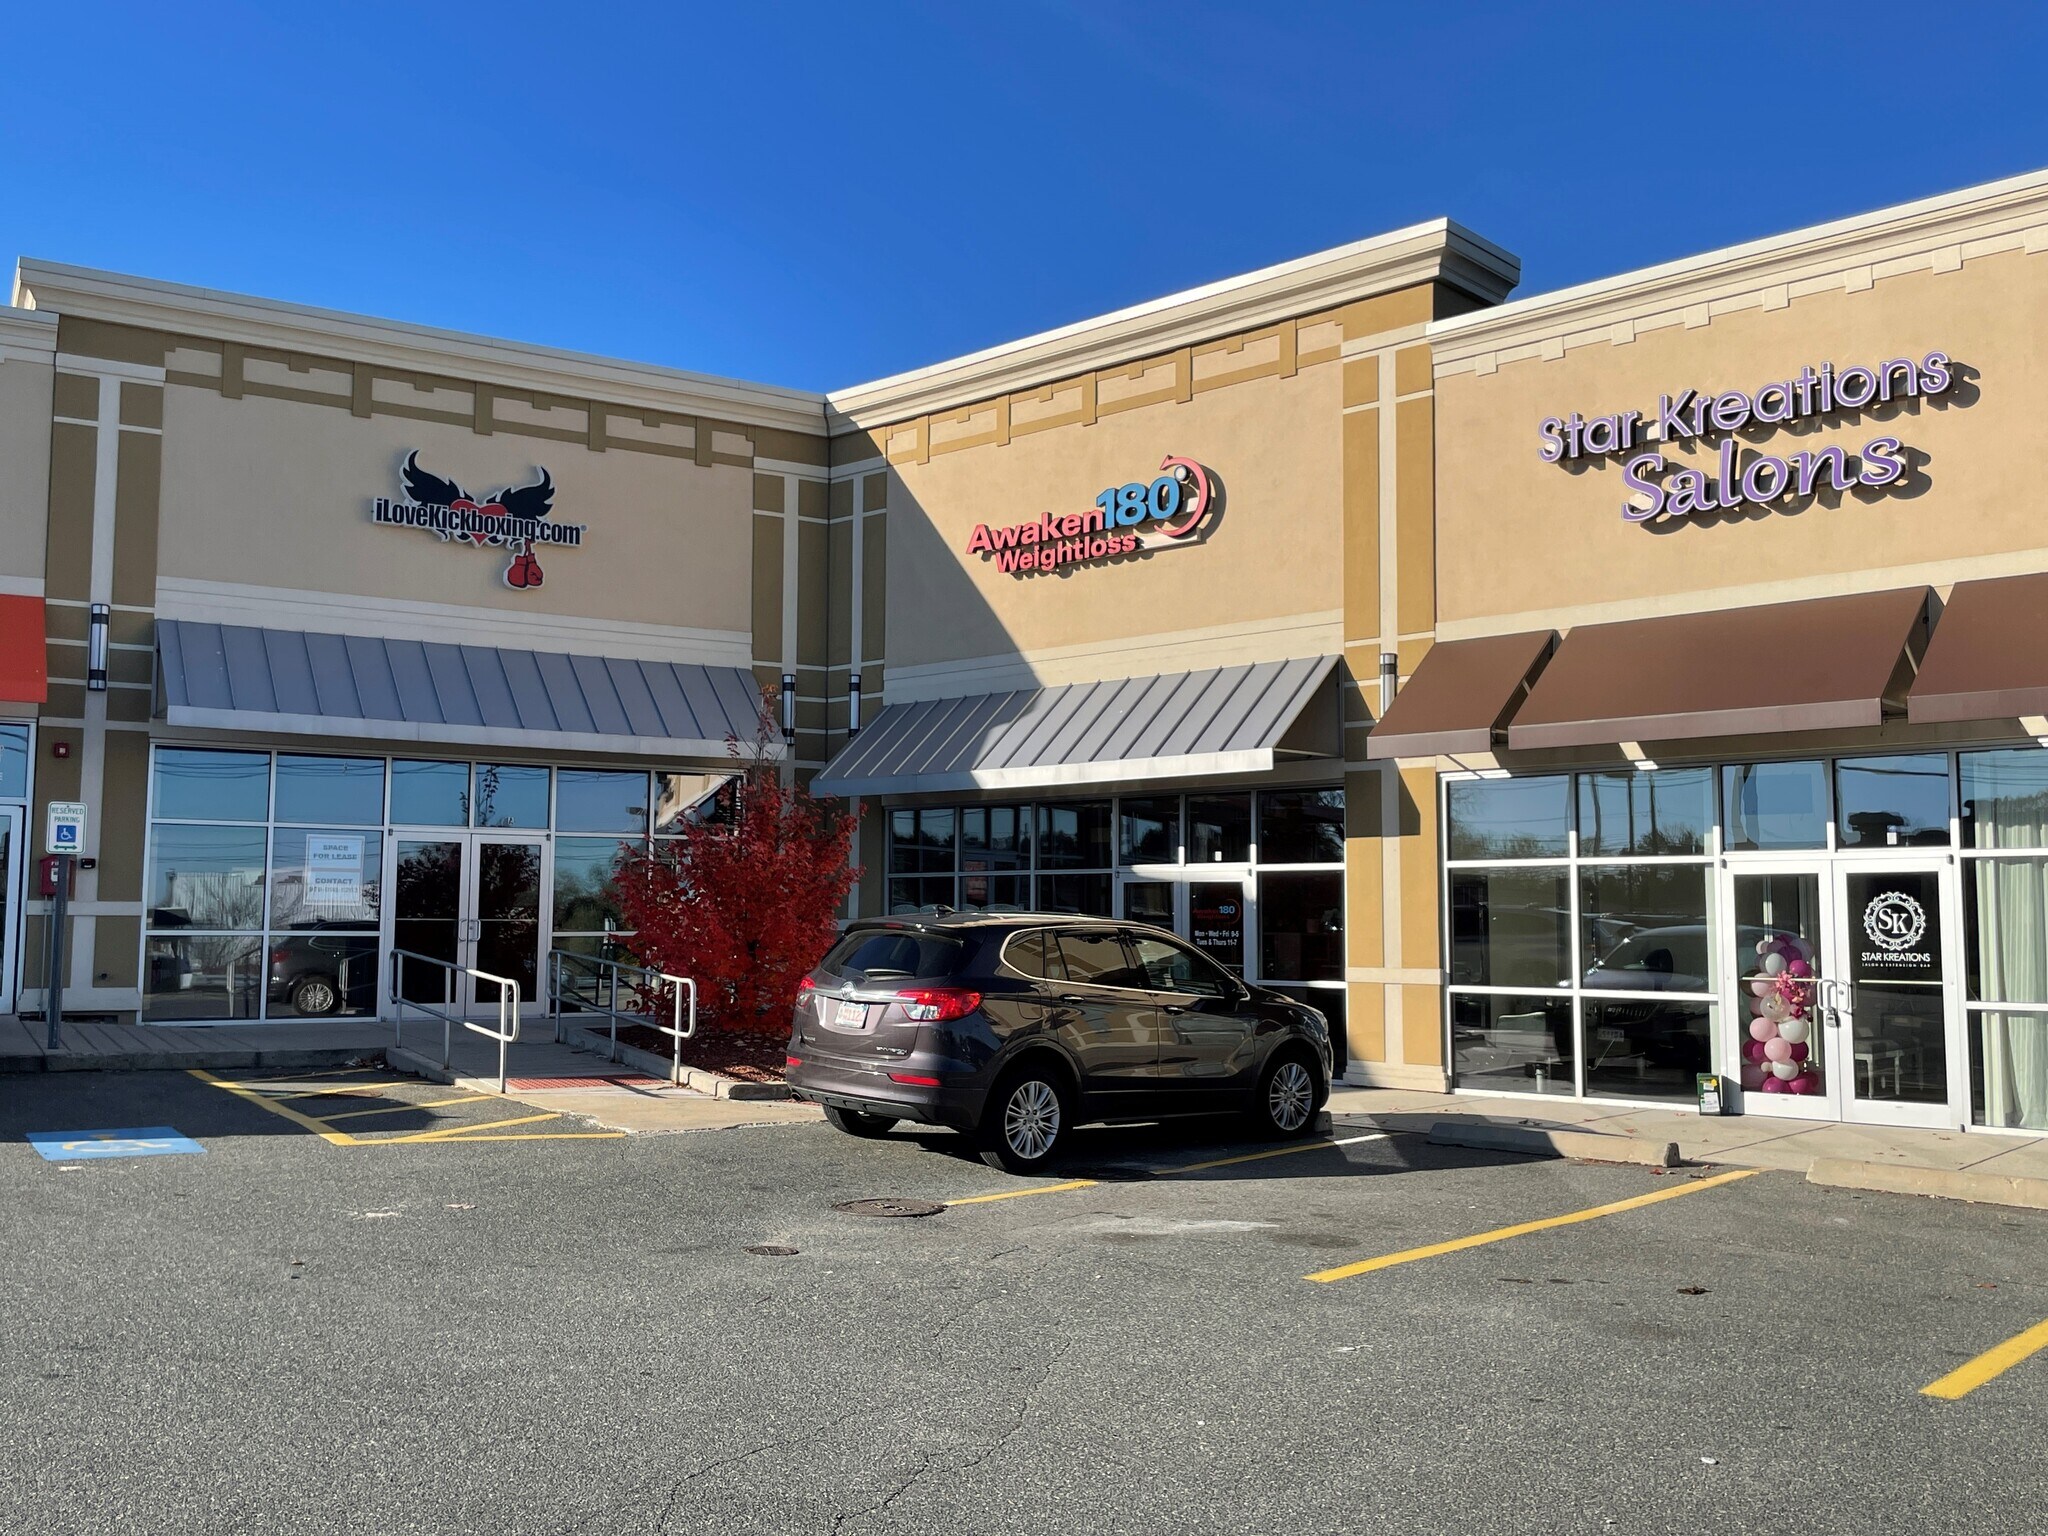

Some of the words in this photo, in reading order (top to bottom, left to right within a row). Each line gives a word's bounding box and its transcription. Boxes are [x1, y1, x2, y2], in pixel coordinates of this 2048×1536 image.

[1537, 409, 1640, 464] Star
[1658, 350, 1952, 442] Kreations
[1621, 436, 1905, 523] Salons
[375, 497, 581, 546] iLoveKickboxing.com
[995, 534, 1136, 573] Weightloss
[51, 807, 84, 815] RESERVED
[1218, 905, 1235, 914] 180
[1878, 908, 1909, 934] SK
[1861, 952, 1882, 961] STAR
[1883, 952, 1931, 962] KREATIONS
